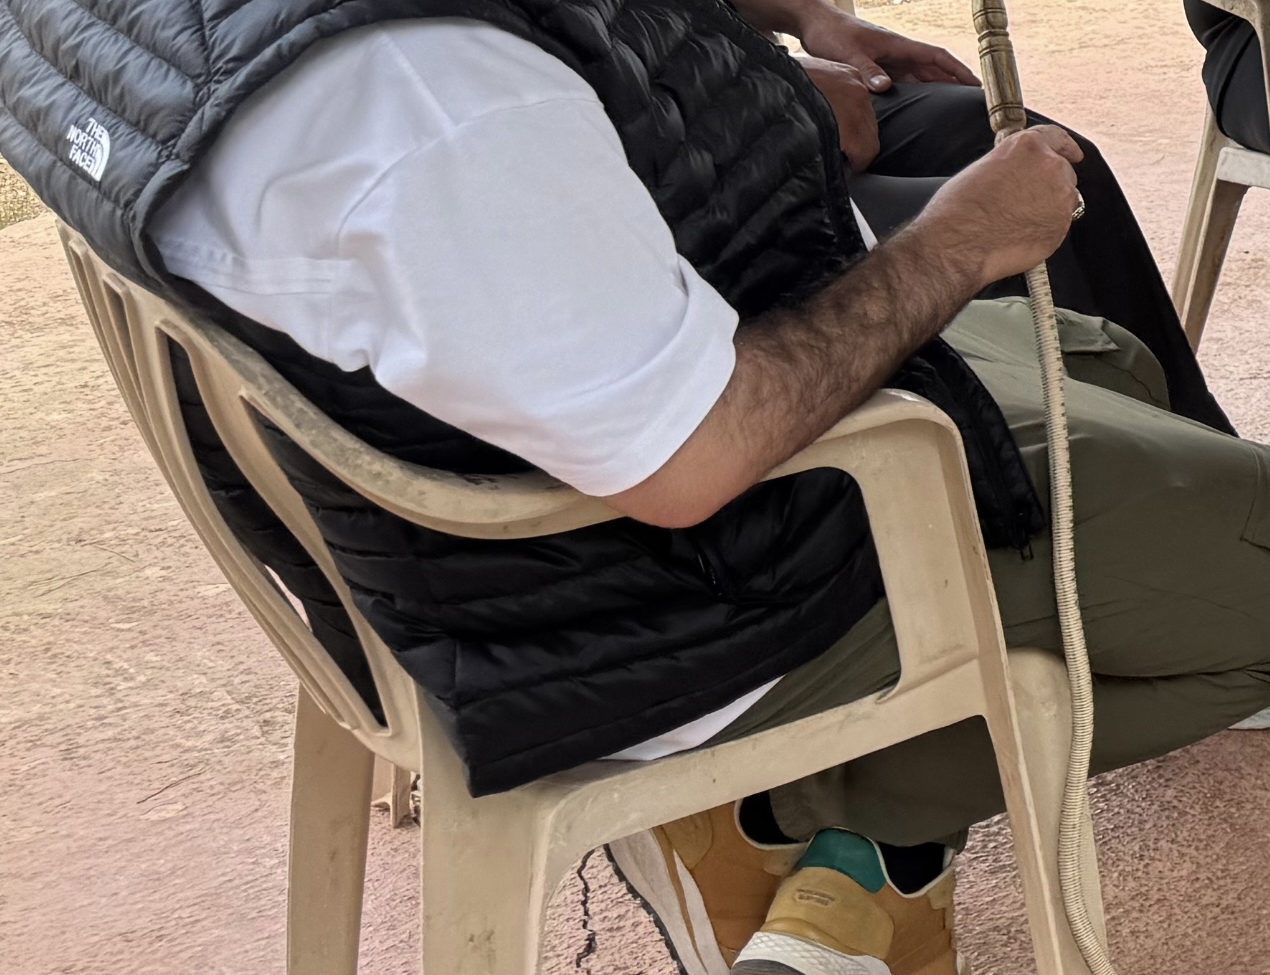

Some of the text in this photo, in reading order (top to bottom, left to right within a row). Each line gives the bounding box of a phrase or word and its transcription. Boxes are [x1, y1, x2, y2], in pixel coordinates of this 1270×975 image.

[66, 124, 99, 157] NORTH
[86, 117, 104, 141] THE
[69, 144, 95, 172] FACE
